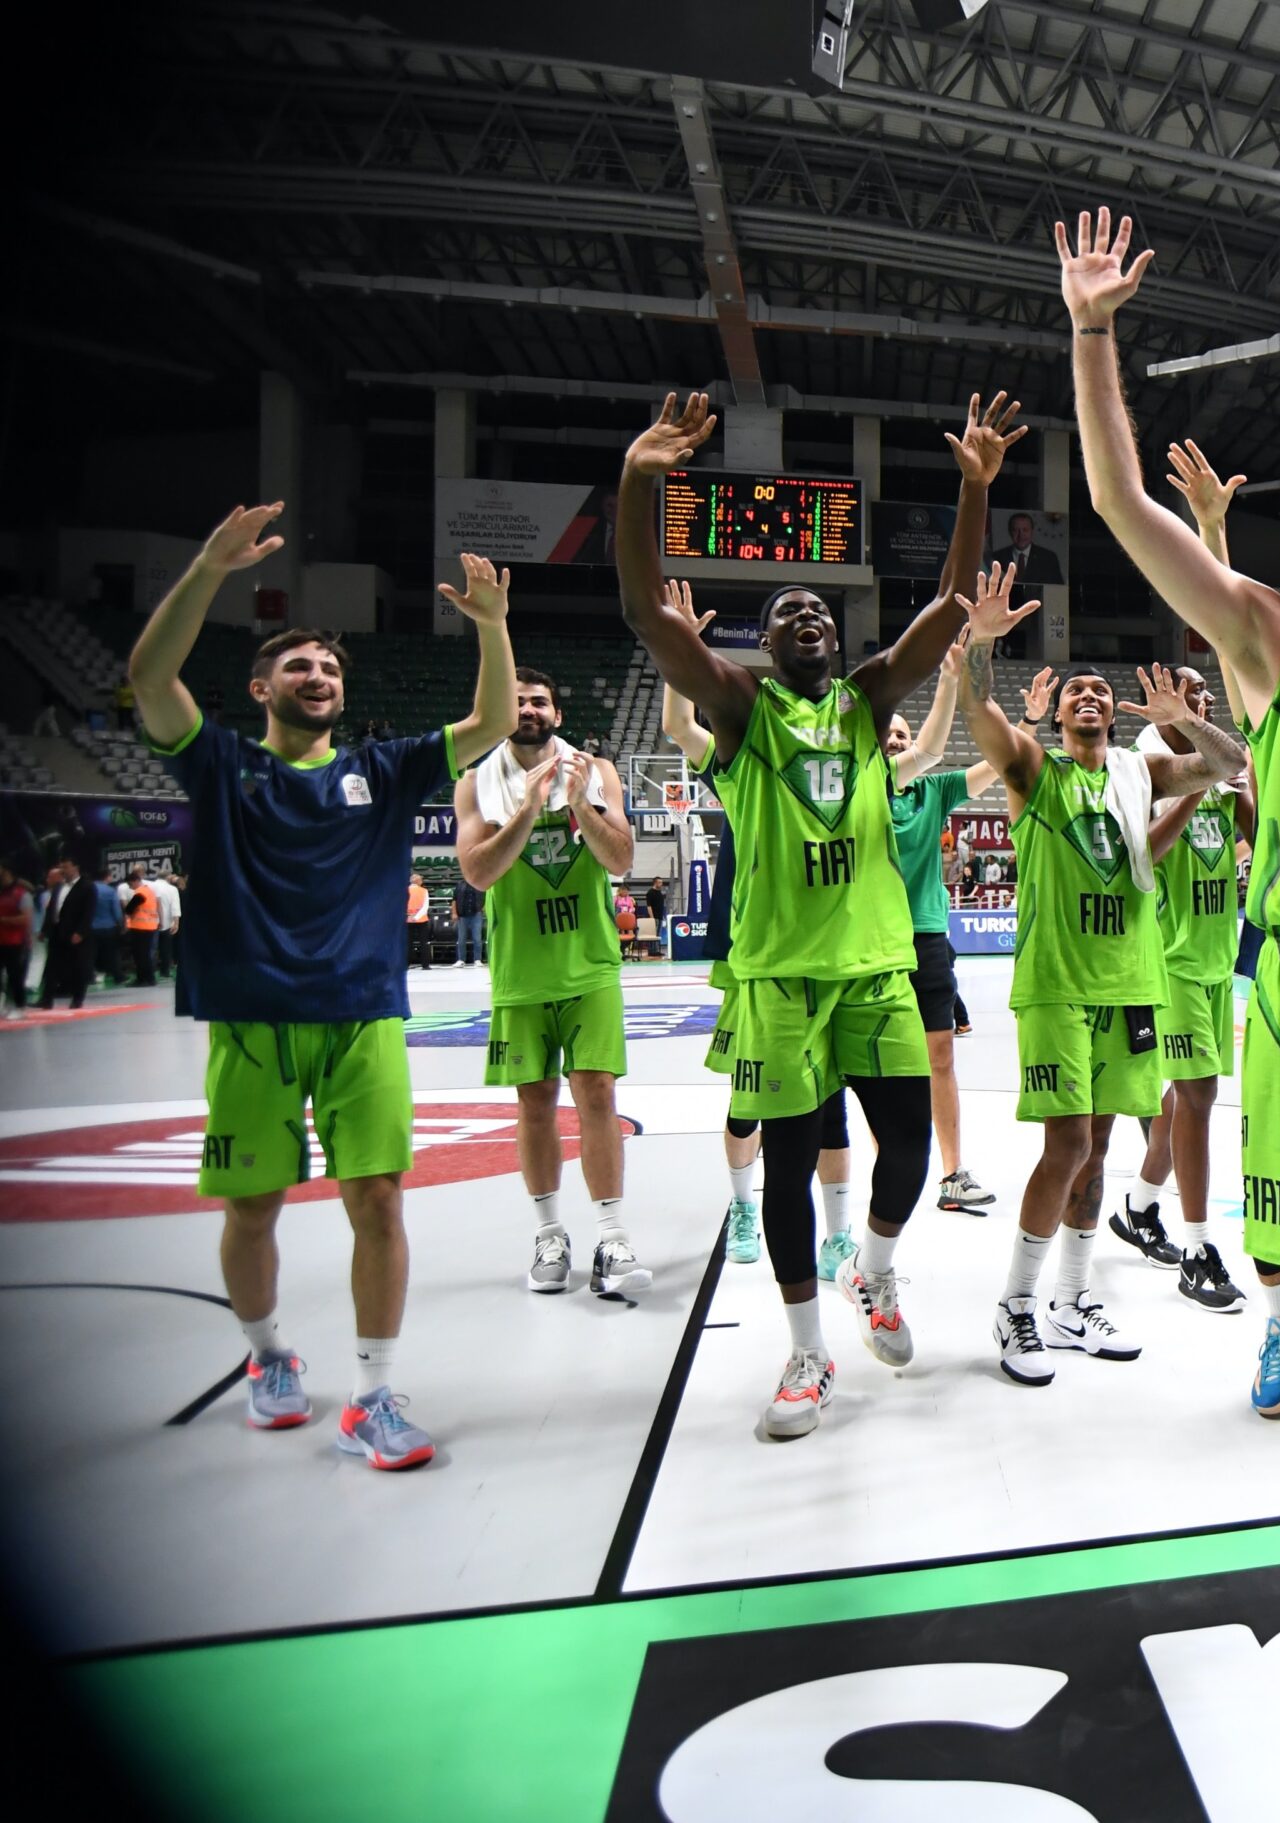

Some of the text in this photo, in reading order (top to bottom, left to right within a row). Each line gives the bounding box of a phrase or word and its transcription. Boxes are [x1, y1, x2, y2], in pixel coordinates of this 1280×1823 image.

[739, 544, 795, 561] 104 91
[803, 759, 846, 802] 16
[649, 816, 667, 828] 111
[530, 829, 571, 866] 32
[1092, 822, 1114, 860] 5
[804, 837, 856, 888] FIAT
[536, 894, 580, 936] FIAT
[1080, 892, 1126, 937] FIAT
[1192, 878, 1228, 916] FIAT
[712, 1028, 734, 1055] FIAT
[1163, 1034, 1194, 1060] FIAT
[1024, 1063, 1060, 1093] FIAT
